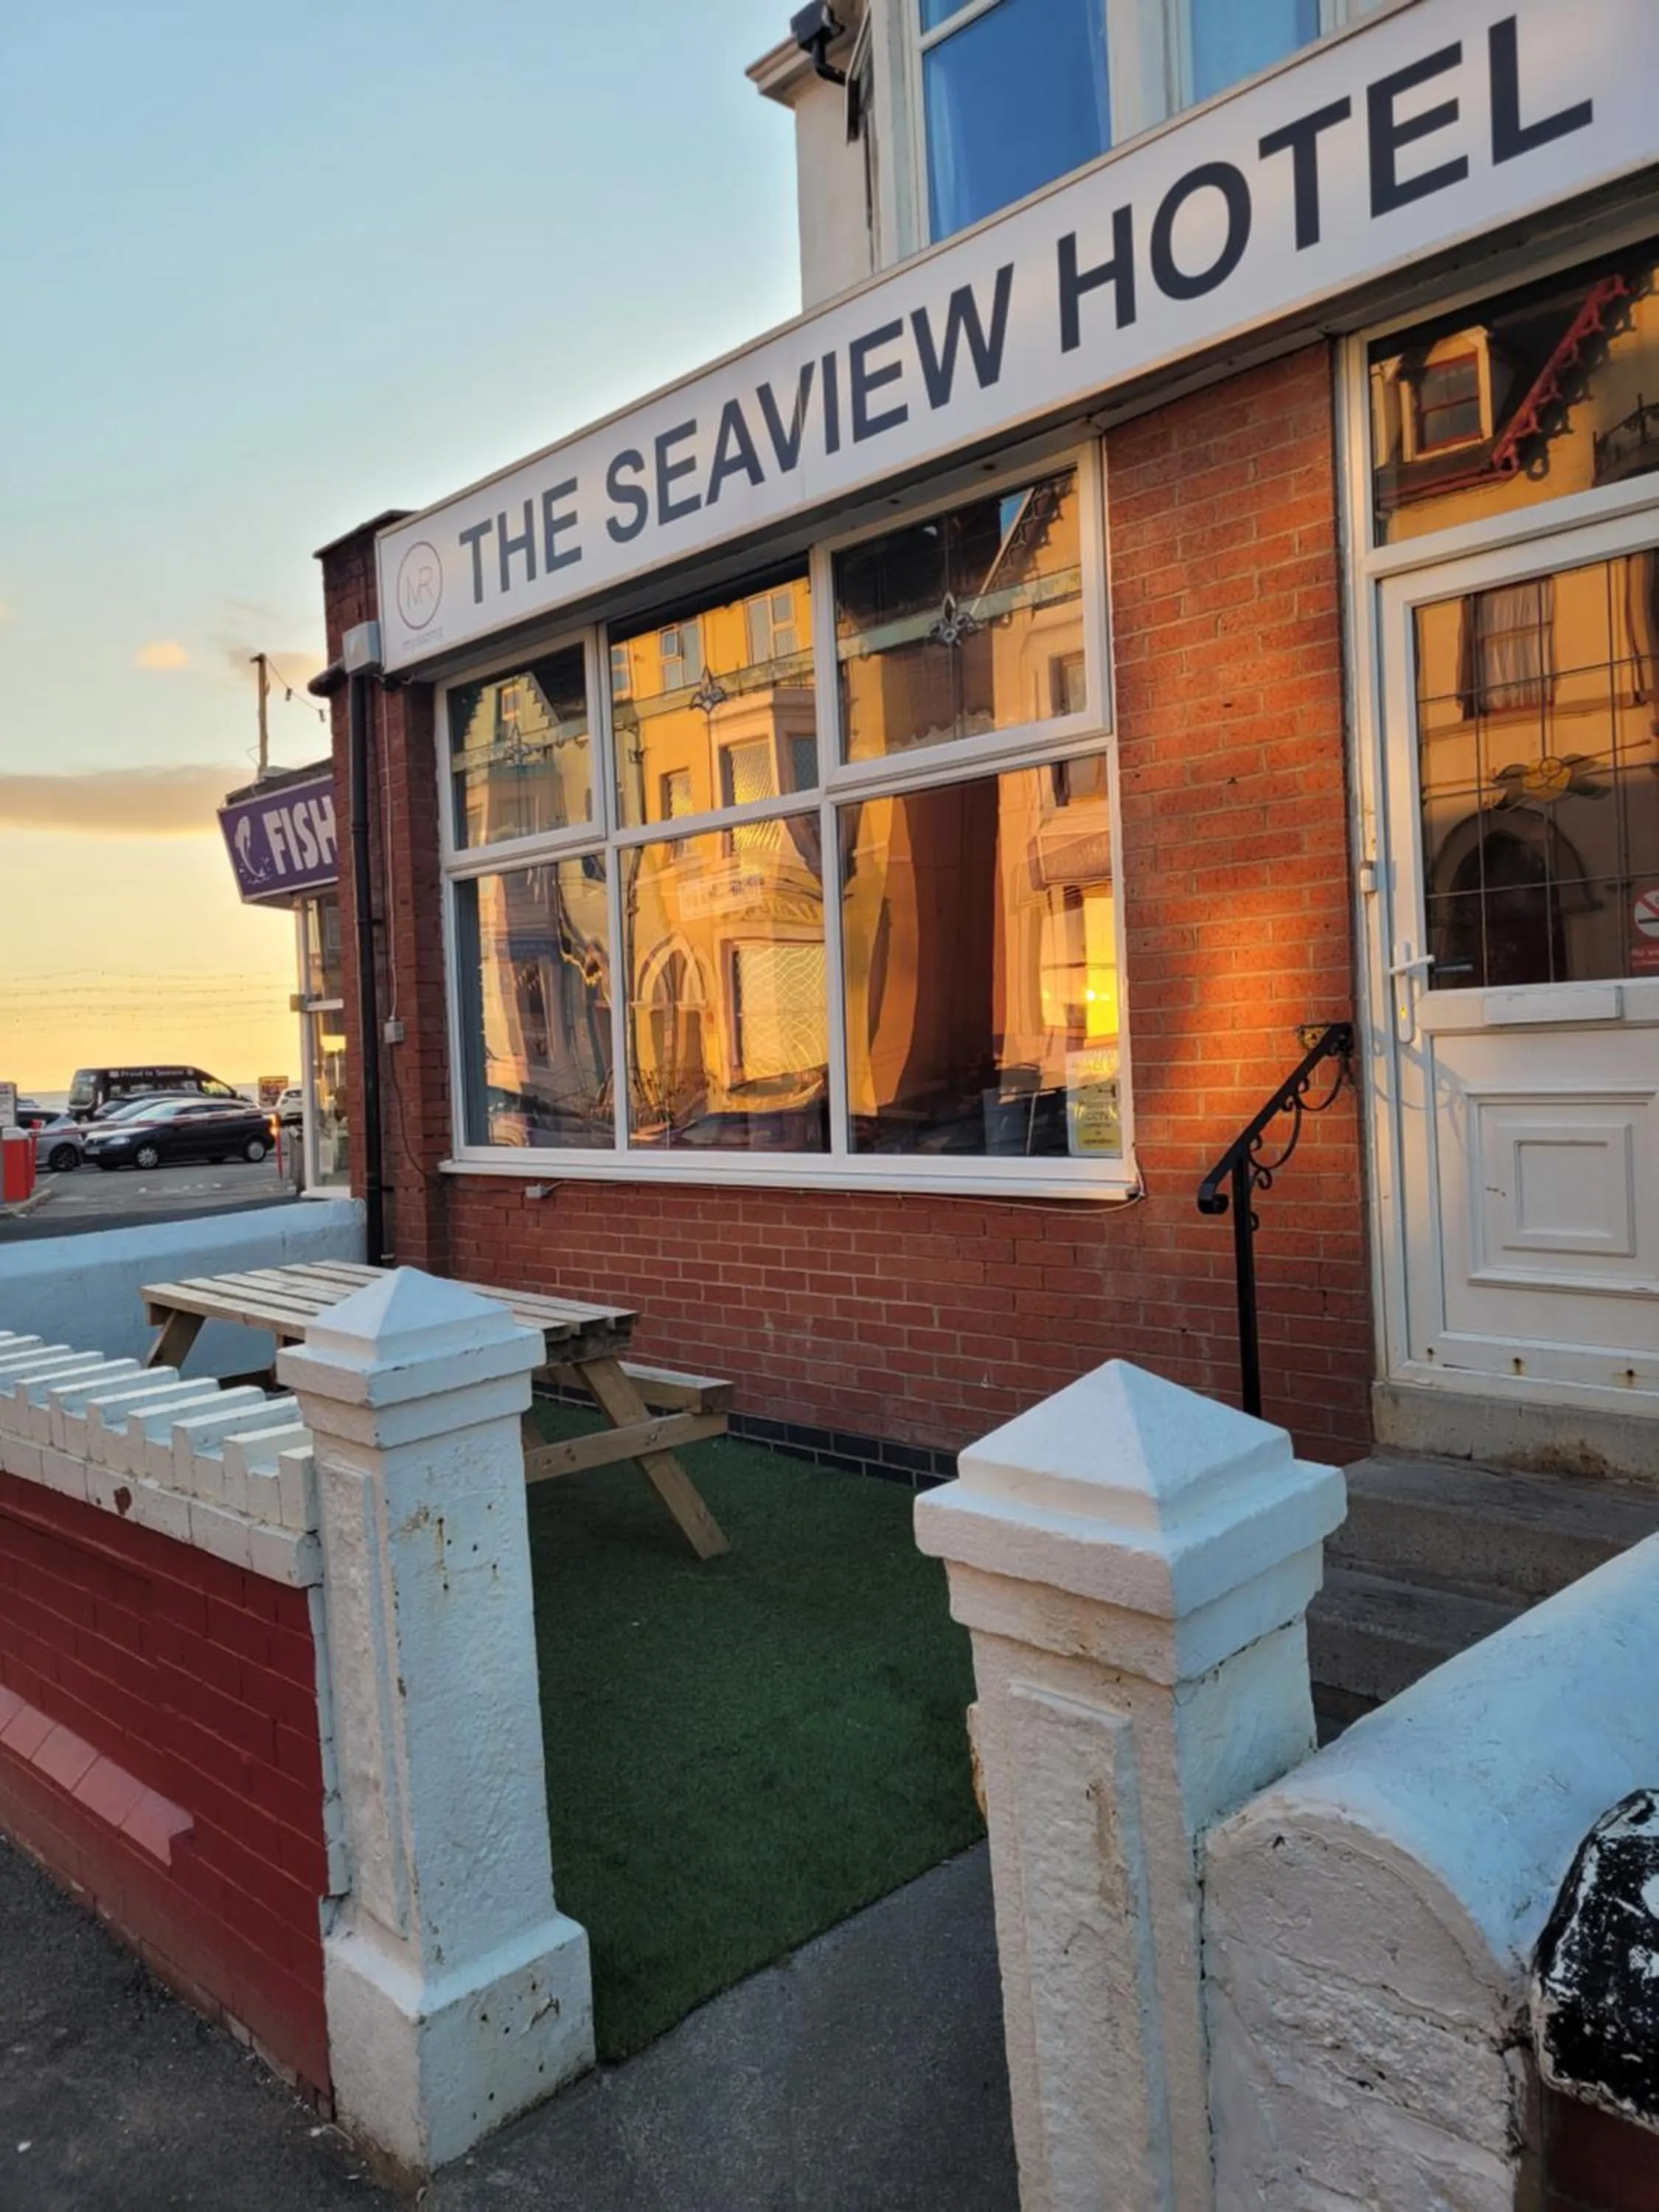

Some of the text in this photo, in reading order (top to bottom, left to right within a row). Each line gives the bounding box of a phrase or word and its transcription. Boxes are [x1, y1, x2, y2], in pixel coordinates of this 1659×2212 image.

[459, 13, 1594, 604] THE SEAVIEW HOTEL
[262, 794, 338, 876] FISH
